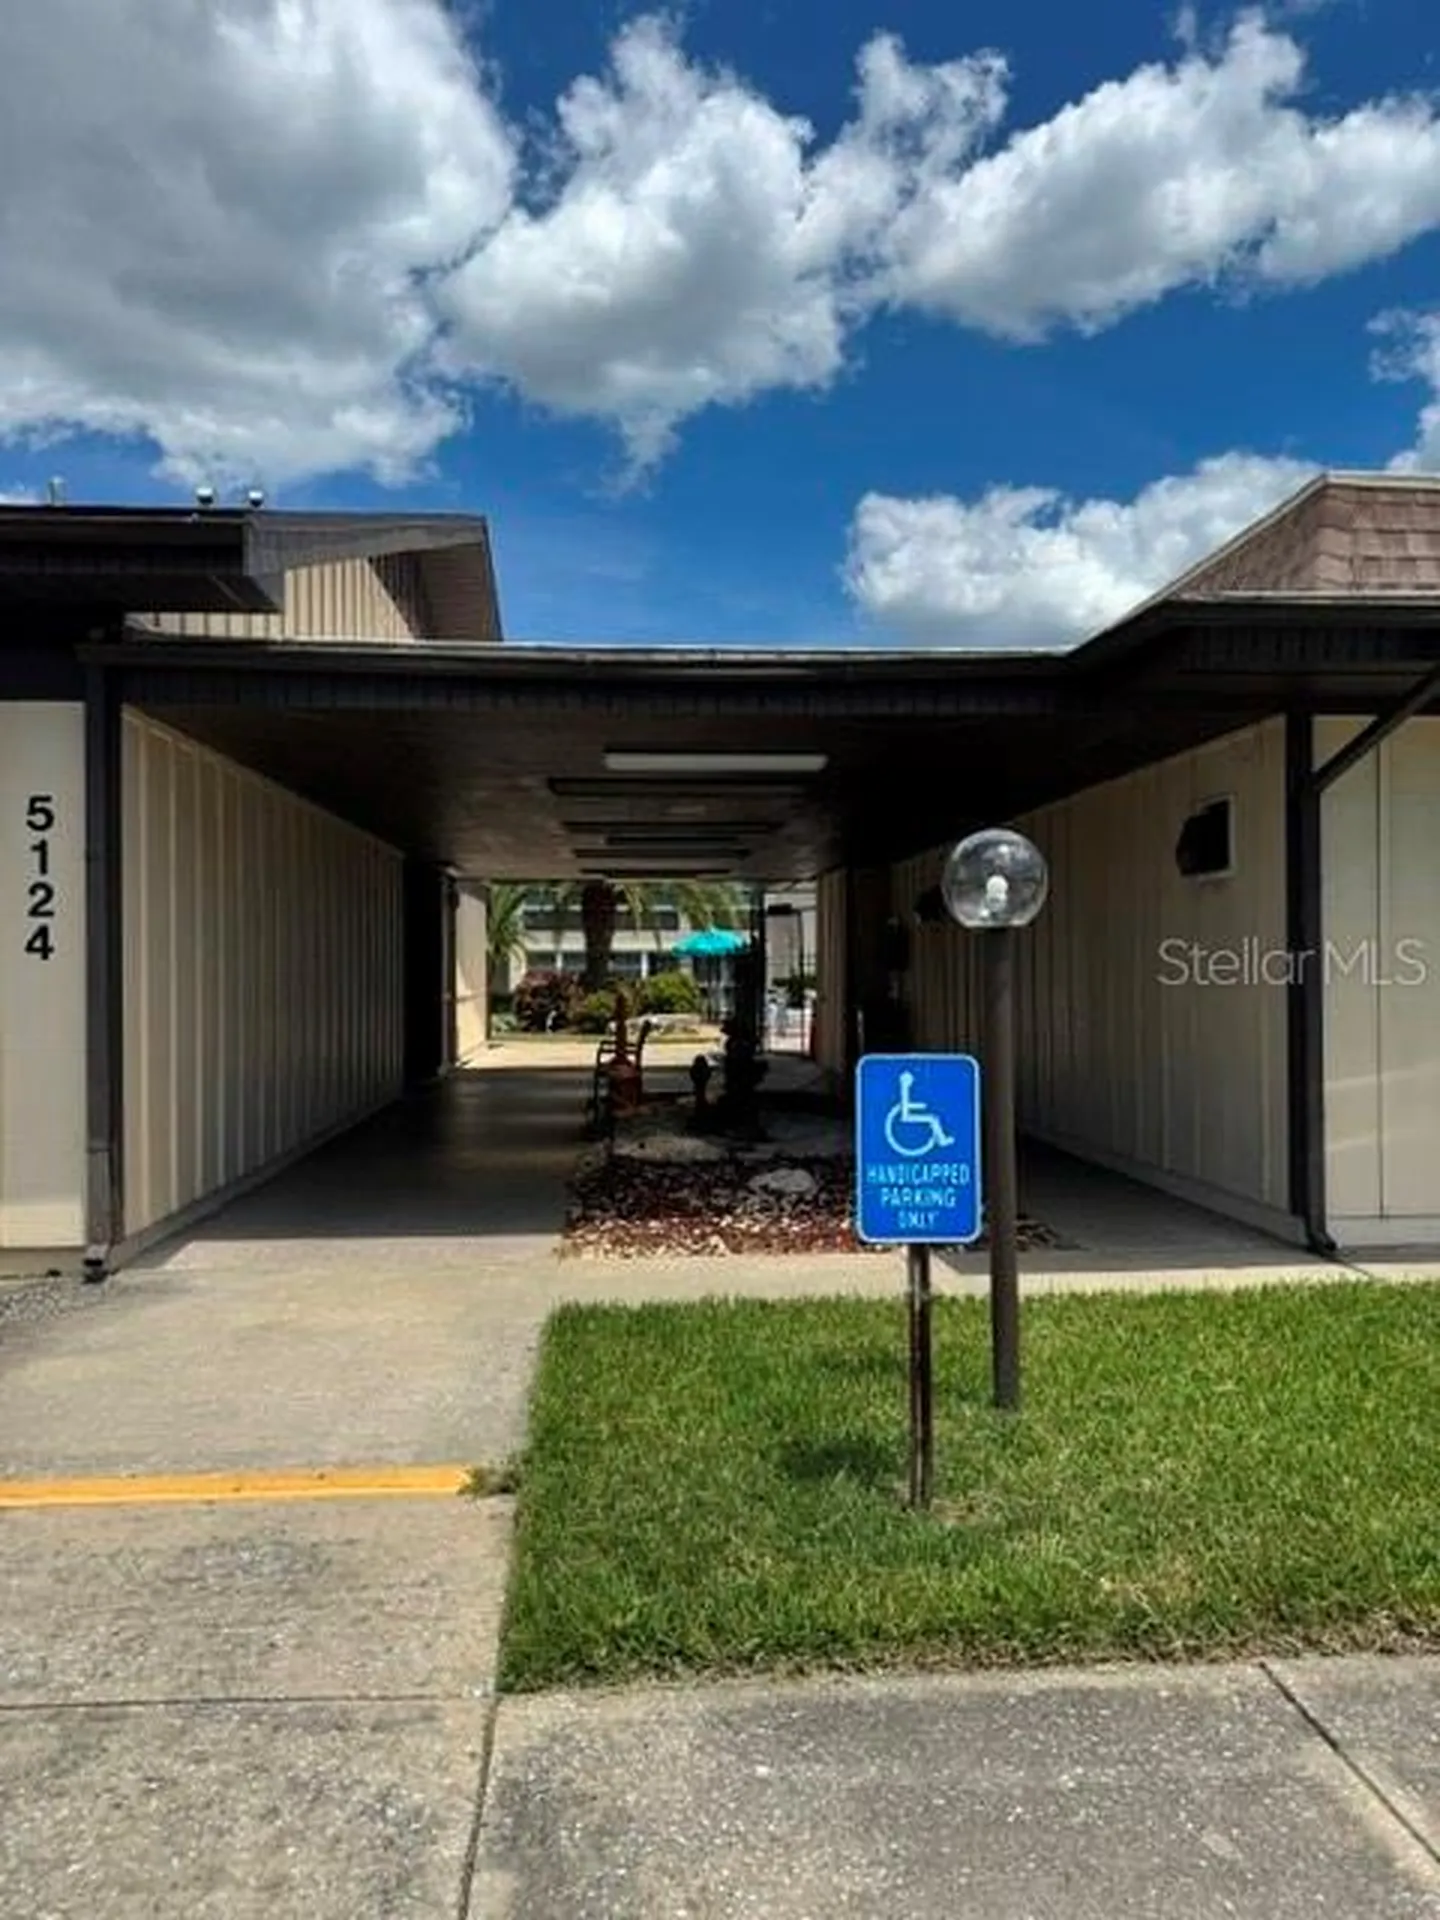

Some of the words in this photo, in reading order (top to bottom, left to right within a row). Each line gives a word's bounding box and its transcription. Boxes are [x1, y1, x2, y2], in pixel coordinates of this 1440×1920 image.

[25, 794, 55, 961] 5124
[866, 1163, 970, 1185] HANDICAPPED
[881, 1187, 956, 1208] PARKING
[898, 1209, 939, 1230] ONLY
